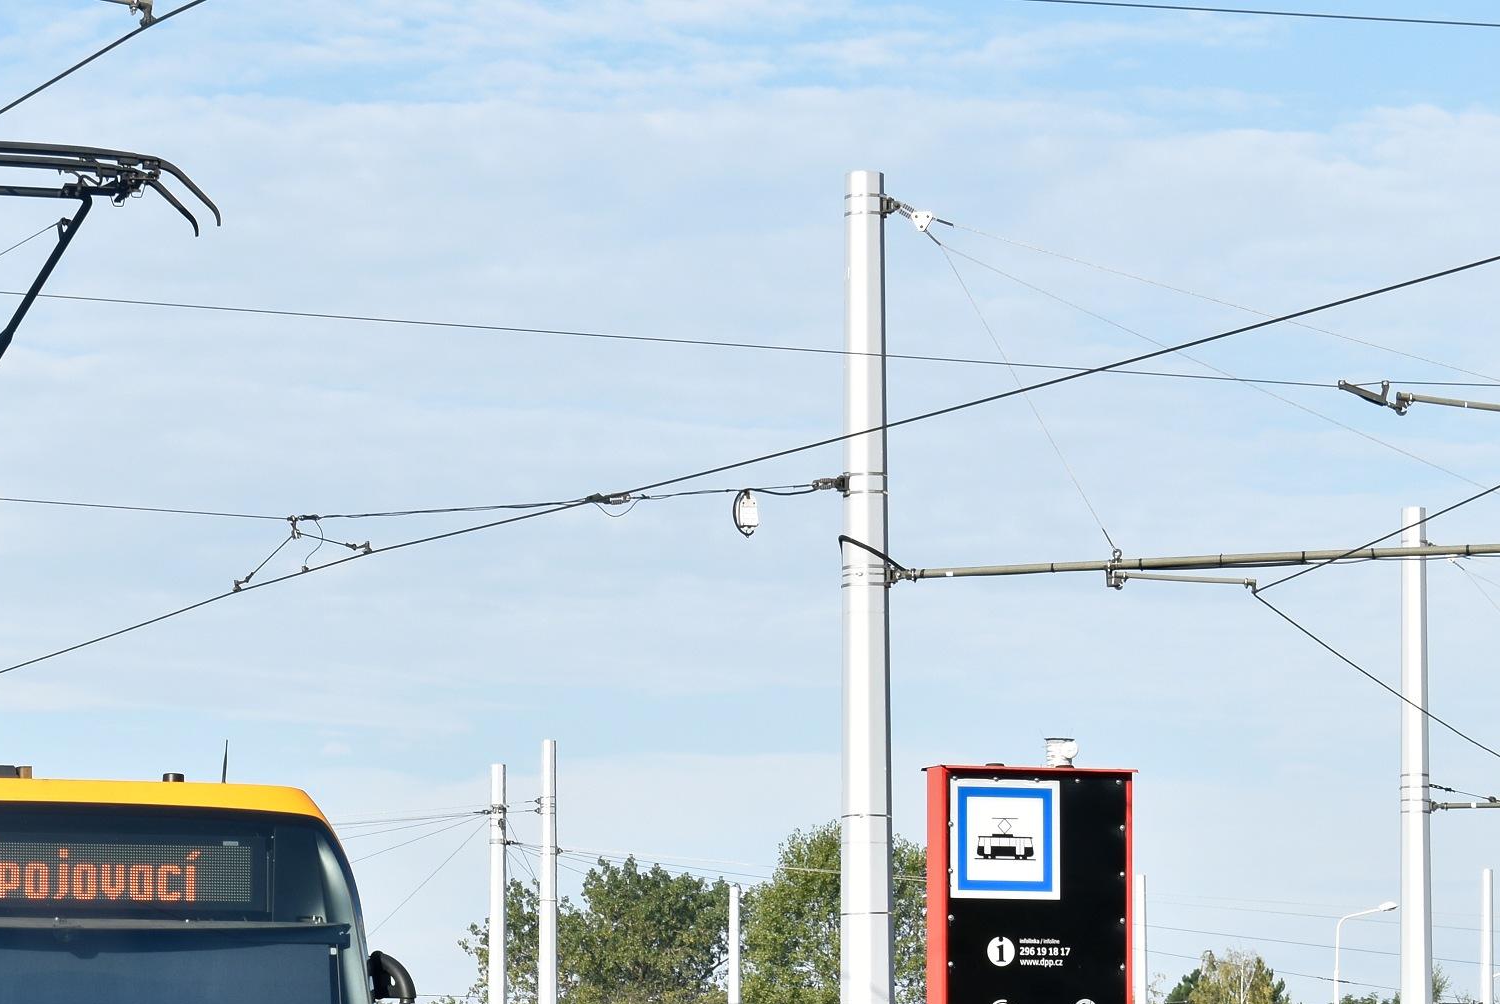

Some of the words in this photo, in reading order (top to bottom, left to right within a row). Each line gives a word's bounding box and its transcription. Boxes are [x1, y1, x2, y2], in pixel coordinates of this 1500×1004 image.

[1019, 946, 1035, 956] 296
[1036, 947, 1047, 956] 19
[1048, 947, 1059, 956] 18
[1060, 947, 1071, 956] 17
[1019, 957, 1063, 968] www.dpp.cz
